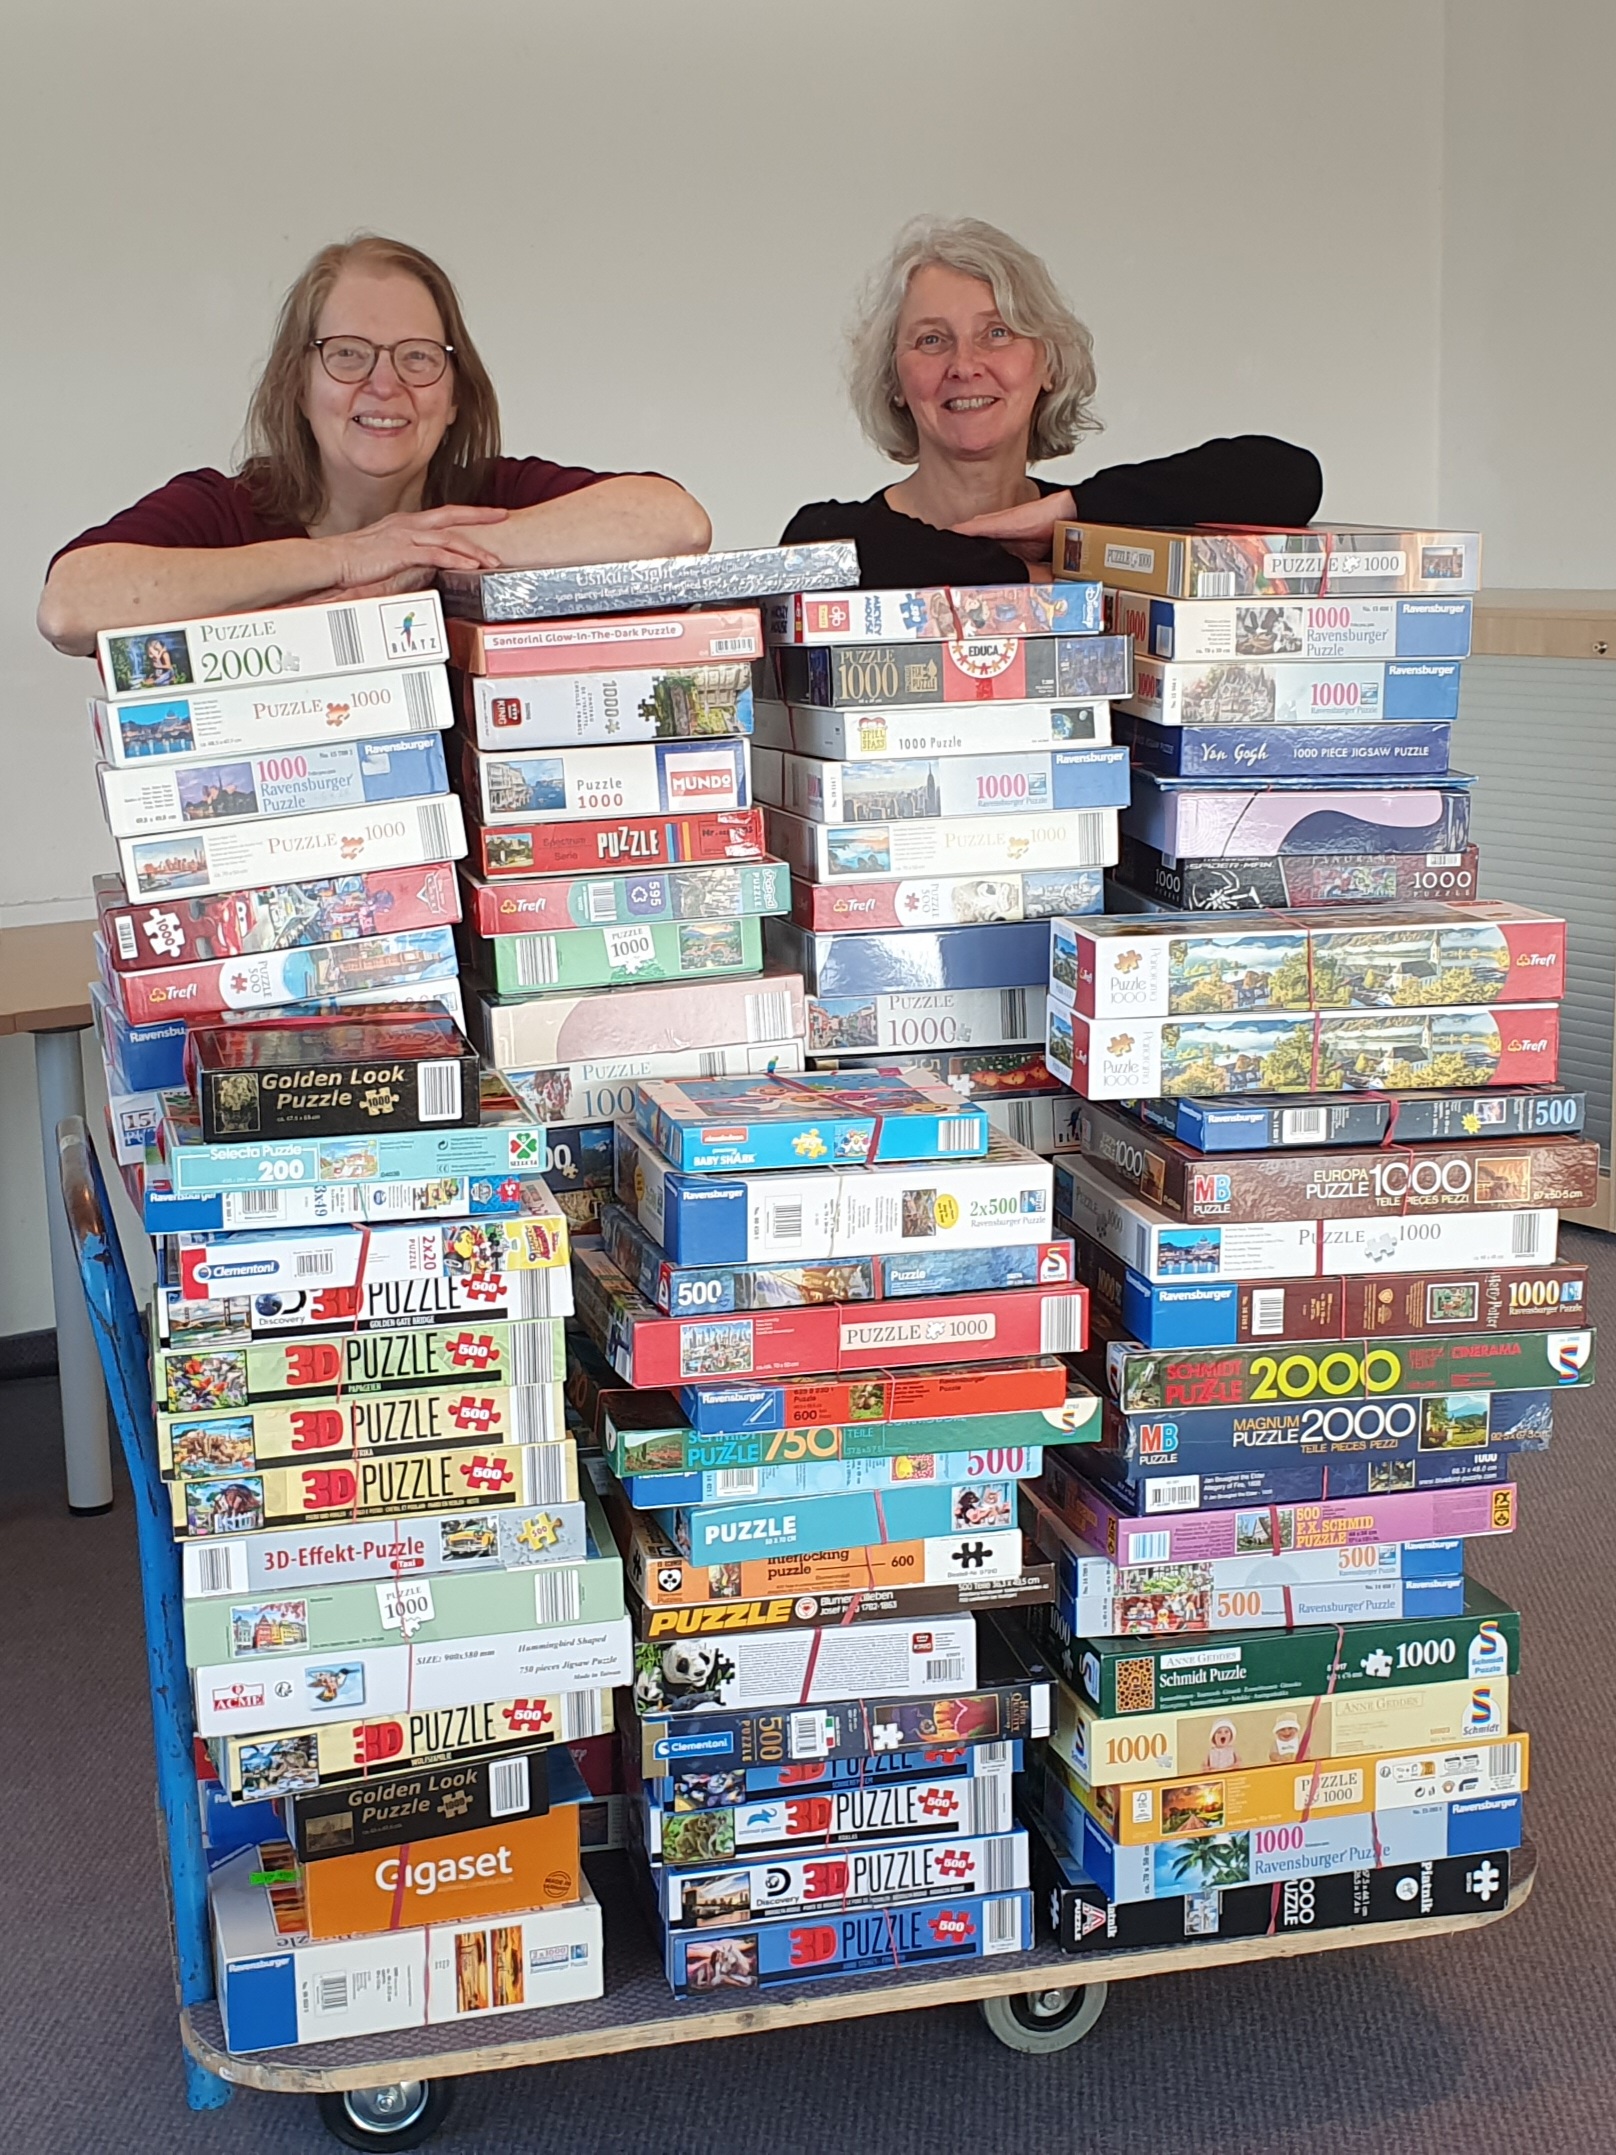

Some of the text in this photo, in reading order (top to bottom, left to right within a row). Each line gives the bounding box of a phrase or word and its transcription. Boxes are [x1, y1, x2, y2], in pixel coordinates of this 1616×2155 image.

[1271, 557, 1399, 573] PUZZLE 1000
[1307, 607, 1350, 629] 1000
[1403, 604, 1465, 615] Ravensburger
[200, 621, 276, 643] PUZZLE
[492, 625, 677, 646] Santorini Glow-In-The-Dark Puzzle
[1307, 629, 1389, 644] Ravensburger
[392, 637, 437, 653] BLATZ
[969, 645, 999, 657] EDUCA
[1307, 644, 1344, 656] Puzzle
[201, 644, 285, 682] 2000
[840, 649, 896, 664] PUZZLE
[1389, 666, 1455, 676] Ravensburger
[838, 663, 898, 700] 1000
[603, 681, 619, 718] 1000
[1311, 682, 1359, 706] 1000
[253, 688, 392, 720] PUZZLE 1000
[497, 700, 507, 725] KING
[365, 738, 436, 755] Ravensburger
[899, 736, 962, 750] 1000 Puzzle
[1293, 746, 1429, 758] 1000 PIECE JIGSAW PUZZLE
[1056, 751, 1124, 765] Ravensburger
[1234, 742, 1269, 766] Gogh
[257, 755, 308, 782] 1000
[577, 778, 622, 791] Puzzle
[672, 774, 732, 791] MUNDO
[976, 774, 1026, 799] 1000
[262, 796, 306, 812] Puzzle
[578, 793, 623, 809] 1000
[268, 822, 406, 854] PUZZLE 1000
[597, 827, 659, 858] PUZZLE
[944, 828, 1066, 849] PUZZLE 1000
[1412, 871, 1472, 889] 1000
[648, 881, 661, 906] 595
[517, 898, 546, 913] Trefl
[847, 898, 876, 912] Trefl
[611, 928, 643, 941] PUZZLE
[610, 938, 650, 958] 1000
[1529, 953, 1556, 968] Trefl
[1110, 976, 1146, 993] Puzzle
[889, 994, 955, 1011] PUZZLE
[888, 1017, 956, 1046] 1000
[1522, 1039, 1547, 1053] Trefl
[261, 1065, 406, 1090] Golden Look
[583, 1061, 651, 1081] PUZZLE
[1103, 1060, 1139, 1077] Puzzle
[276, 1090, 351, 1110] Puzzle
[1535, 1099, 1578, 1126] 500
[210, 1146, 259, 1161] Selecta
[694, 1153, 755, 1166] BABY SHARK
[258, 1160, 304, 1181] 200
[1314, 1169, 1369, 1182] EUROPA
[1369, 1160, 1472, 1195] 1000
[1194, 1175, 1231, 1203] MB
[1306, 1182, 1369, 1199] PUZZLE
[314, 1185, 328, 1217] 3x49
[970, 1198, 1017, 1217] 2x500
[1441, 1194, 1469, 1203] PEZZI
[1194, 1203, 1231, 1214] PUZZLE
[1400, 1224, 1441, 1240] 1000
[421, 1236, 436, 1270] 2x20
[212, 1262, 275, 1277] Clementoni
[891, 1269, 926, 1282] Puzzle
[678, 1281, 722, 1305] 500
[1159, 1286, 1233, 1303] Ravensburger
[1508, 1280, 1560, 1307] 1000
[259, 1315, 305, 1326] Discovery
[370, 1315, 434, 1328] GOLDEN GATE BRIDGE
[846, 1319, 988, 1345] PUZZLE 1000
[286, 1332, 439, 1385] 3D PUZZLE
[458, 1343, 489, 1357] 500
[1452, 1344, 1521, 1358] CINERAMA
[1166, 1360, 1243, 1380] SCHMIDT
[1250, 1350, 1400, 1400] 2000
[459, 1407, 490, 1421] 500
[793, 1410, 817, 1421] 600
[1233, 1415, 1300, 1431] MAGNUM
[1301, 1403, 1416, 1442] 2000
[290, 1409, 344, 1451] 3D
[1141, 1423, 1178, 1454] MB
[1233, 1429, 1299, 1447] PUZZLE
[765, 1428, 841, 1461] 750
[1301, 1439, 1397, 1453] TEILE PIECES PEZZI
[688, 1443, 759, 1466] PUZZLE
[1140, 1454, 1178, 1465] PUZZLE
[302, 1456, 452, 1509] 3D PUZZLE
[472, 1467, 501, 1480] 500
[705, 1515, 796, 1544] PUZZLE
[1322, 1516, 1374, 1532] SCHMID
[1297, 1533, 1346, 1548] PUZZLE
[264, 1537, 425, 1570] 3D-Effekt-Puzzle
[1338, 1545, 1376, 1569] 500
[398, 1559, 415, 1568] Taxi
[768, 1556, 914, 1580] puzzle 600
[1217, 1591, 1396, 1618] 500 Puzzle
[649, 1599, 793, 1636] PUZZLE
[518, 1635, 607, 1653] Hummingbird Shaped
[1166, 1649, 1237, 1667] ANNE GEDDES
[1396, 1639, 1456, 1669] 1000
[535, 1659, 589, 1674] pieces Jigsaw
[1160, 1666, 1246, 1688] Schmidt Puzzle
[214, 1694, 264, 1710] ACME
[1343, 1703, 1374, 1714] ANNE
[514, 1708, 541, 1721] 500
[410, 1701, 495, 1755] PUZZLE
[671, 1739, 728, 1752] Clementoni
[759, 1717, 782, 1761] 500
[1106, 1733, 1167, 1765] 1000
[347, 1769, 478, 1807] Golden Look
[1324, 1788, 1353, 1802] 1000
[361, 1799, 430, 1823] Puzzle
[784, 1786, 918, 1835] 3D PUZZLE
[927, 1797, 949, 1809] 500
[1452, 1798, 1517, 1814] Ravensburger
[1255, 1826, 1303, 1854] 1000
[375, 1845, 513, 1896] Gigaset
[944, 1858, 966, 1869] 500
[1255, 1850, 1347, 1874] Ravensburger
[802, 1848, 934, 1899] 3D PUZZLE
[756, 1896, 799, 1907] Discovery
[939, 1920, 964, 1932] 500
[790, 1911, 922, 1966] 3D PUZZLE
